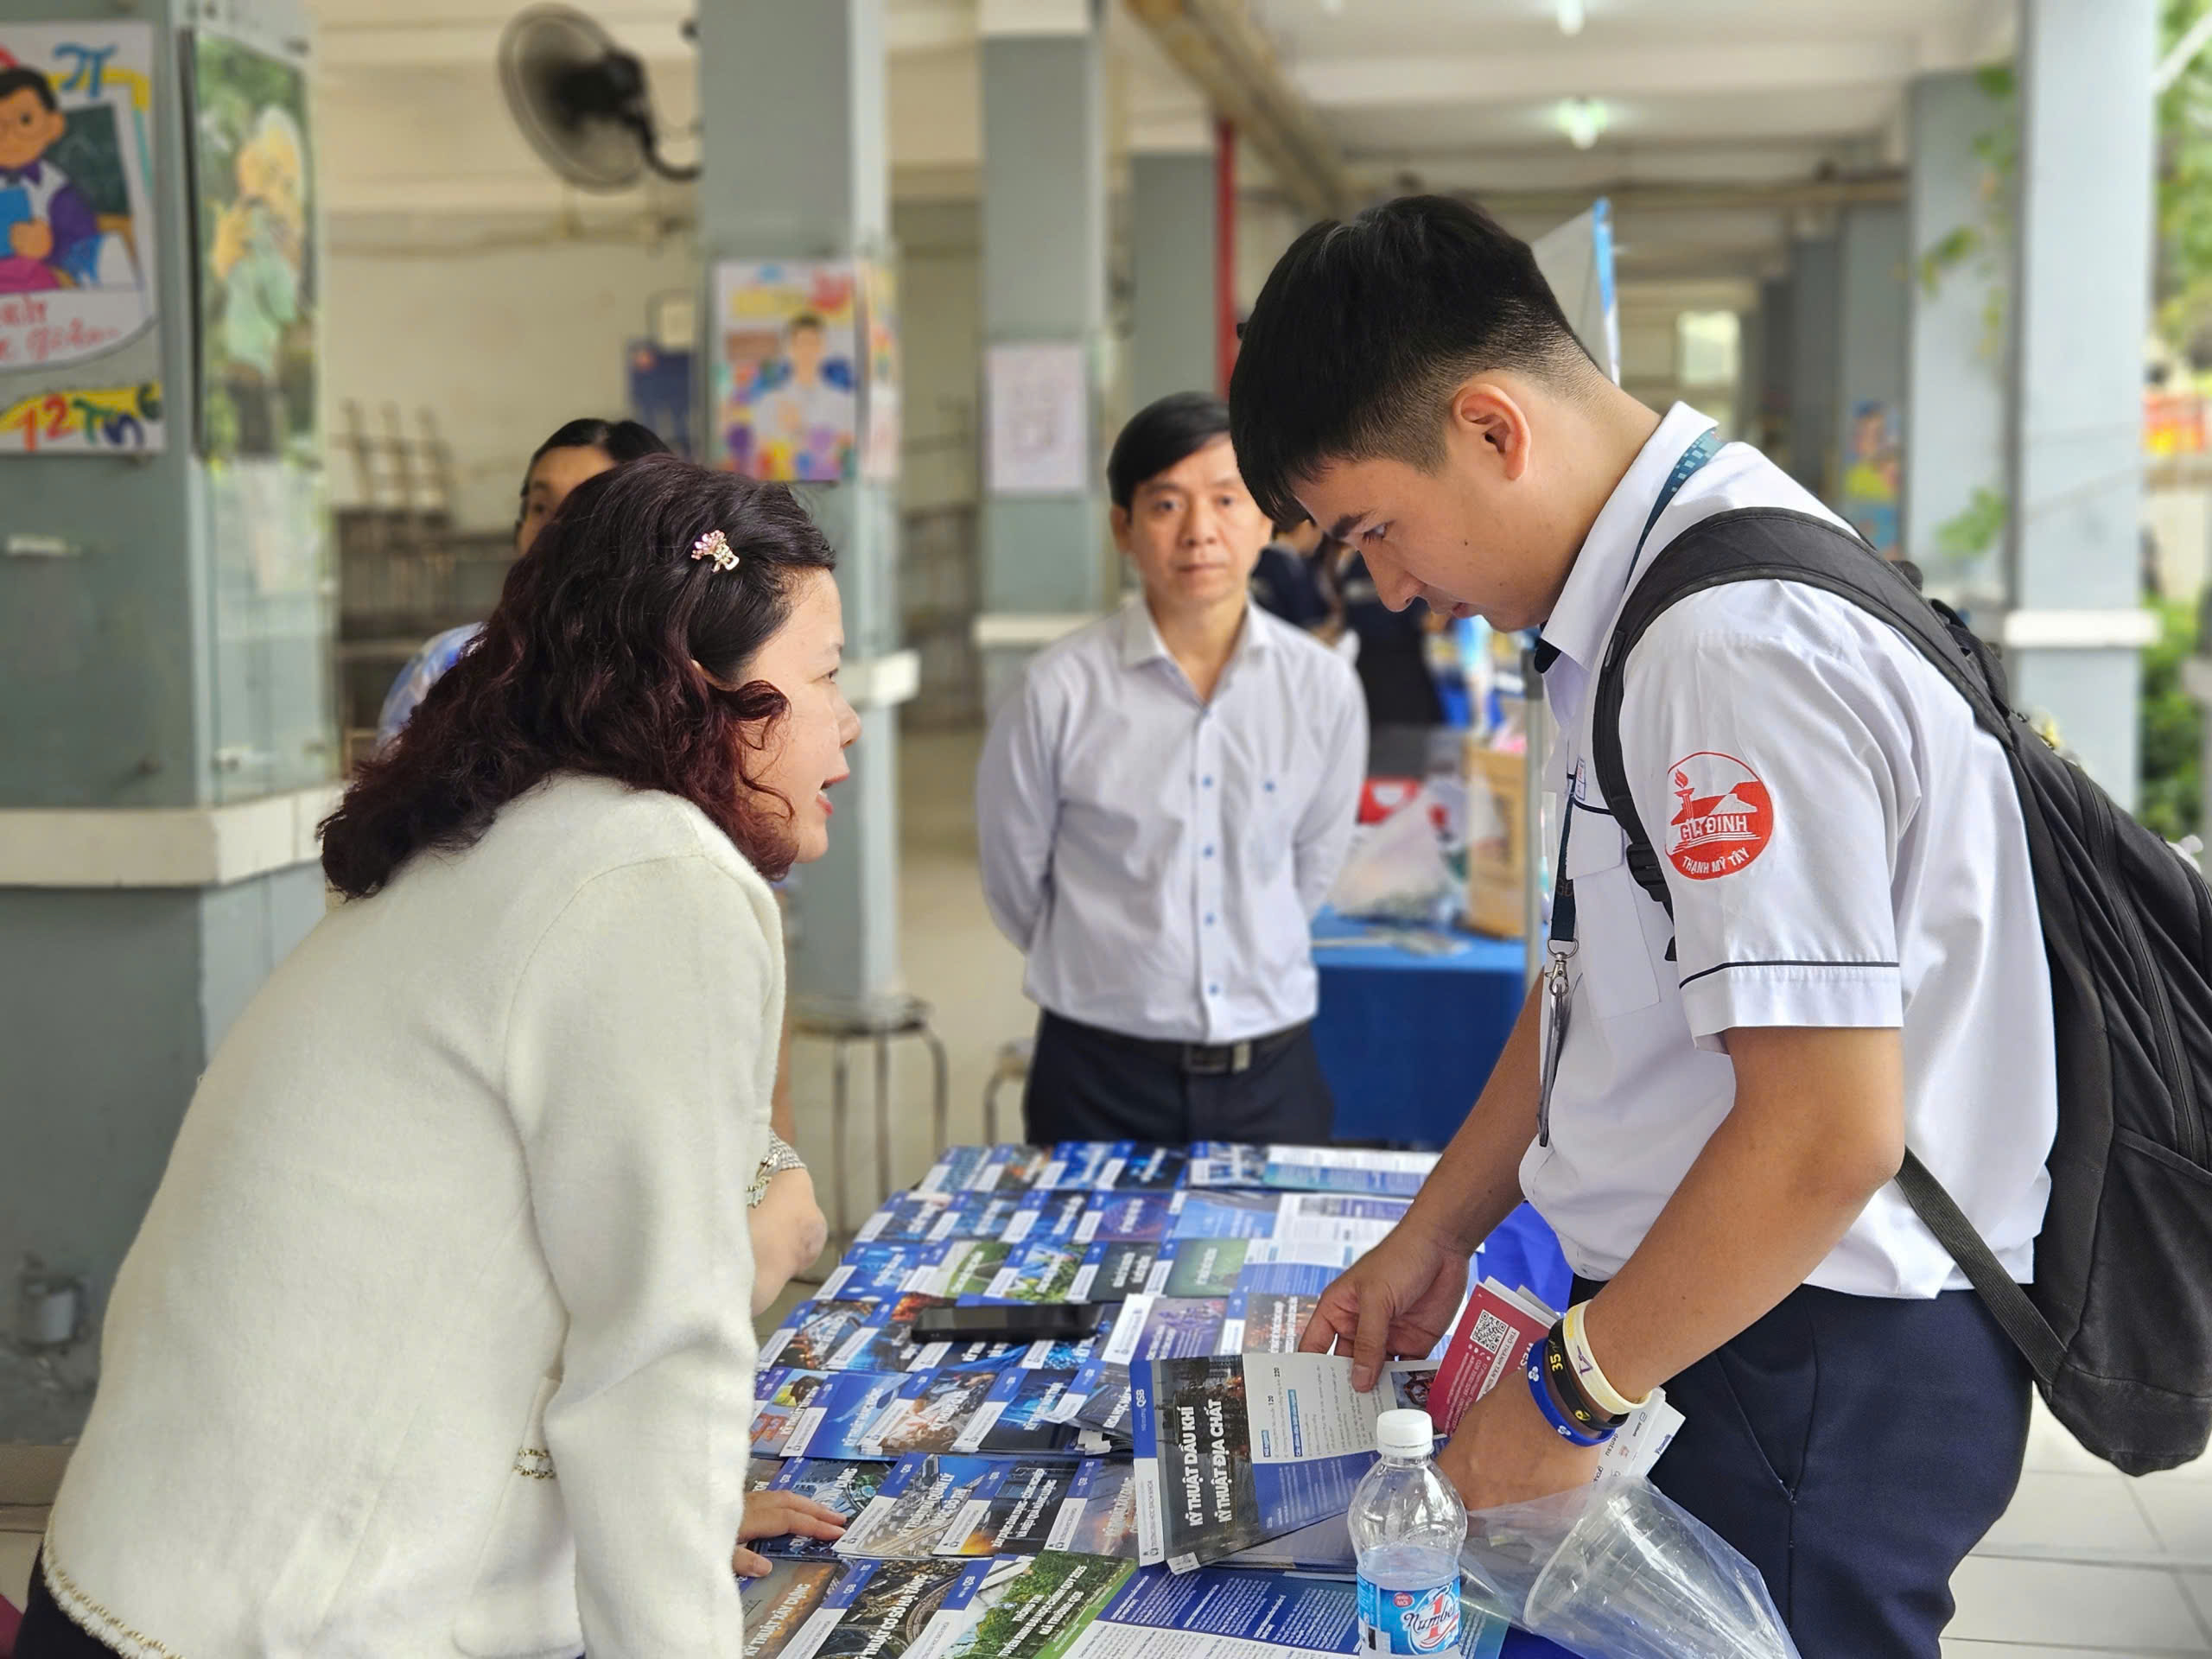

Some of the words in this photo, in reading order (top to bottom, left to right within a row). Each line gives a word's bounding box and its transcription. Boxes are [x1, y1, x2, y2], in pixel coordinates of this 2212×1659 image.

[1682, 855, 1709, 874] THẠNH
[1727, 847, 1750, 867] TÂY
[1549, 1353, 1563, 1372] 35
[1135, 1389, 1147, 1408] QSB
[1176, 1406, 1196, 1431] KHÍ
[1204, 1399, 1224, 1438] CHẤT
[1179, 1433, 1198, 1465] DẦU
[1211, 1438, 1230, 1467] ĐỊA
[1605, 1433, 1618, 1457] dentsu
[939, 1472, 955, 1483] LÝ
[1182, 1466, 1204, 1510] THUẬT
[1211, 1467, 1232, 1510] THUẬT
[1185, 1511, 1204, 1526] KỸ
[1214, 1510, 1232, 1522] KỸ
[905, 1573, 929, 1595] TẦNG
[888, 1605, 906, 1618] SỞ
[898, 1594, 918, 1607] HẠ
[1011, 1603, 1036, 1621] THÔNG
[1014, 1626, 1033, 1640] SINH
[1069, 1565, 1088, 1580] 2025
[750, 1620, 782, 1644] THUẬT
[771, 1605, 793, 1620] XÂY
[881, 1618, 899, 1630] CƠ
[862, 1630, 892, 1656] THUẬT
